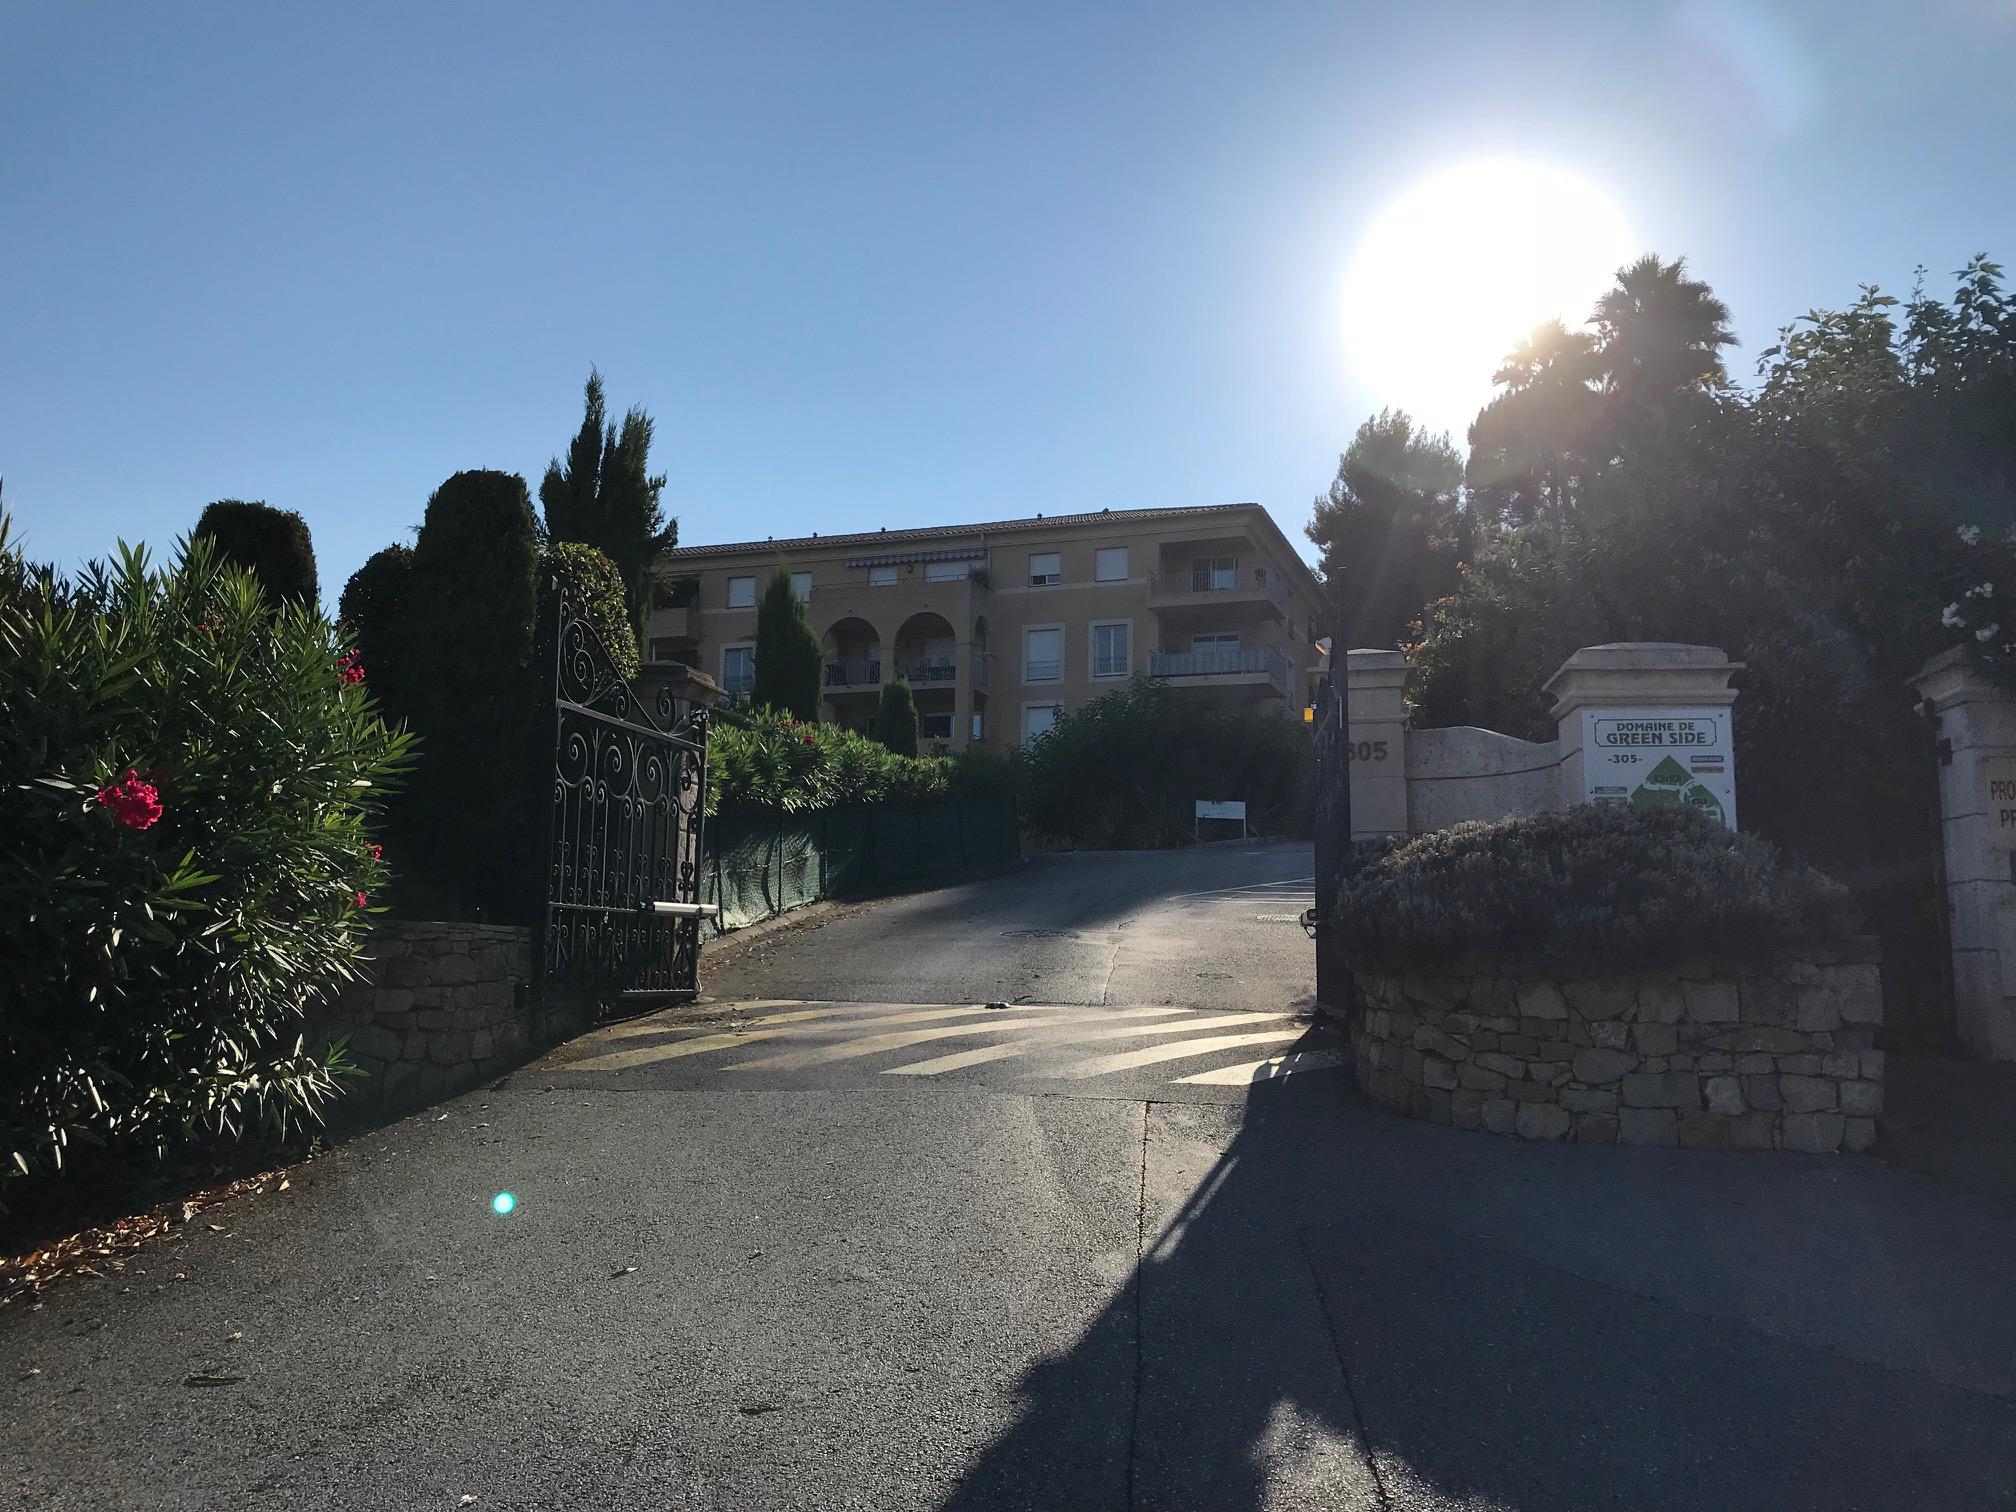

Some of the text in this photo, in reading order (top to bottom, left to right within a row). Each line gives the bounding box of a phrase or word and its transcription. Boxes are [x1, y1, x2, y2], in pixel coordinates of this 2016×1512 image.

[1616, 722, 1695, 731] DOMAINE DE
[1606, 732, 1706, 745] GREEN SIDE
